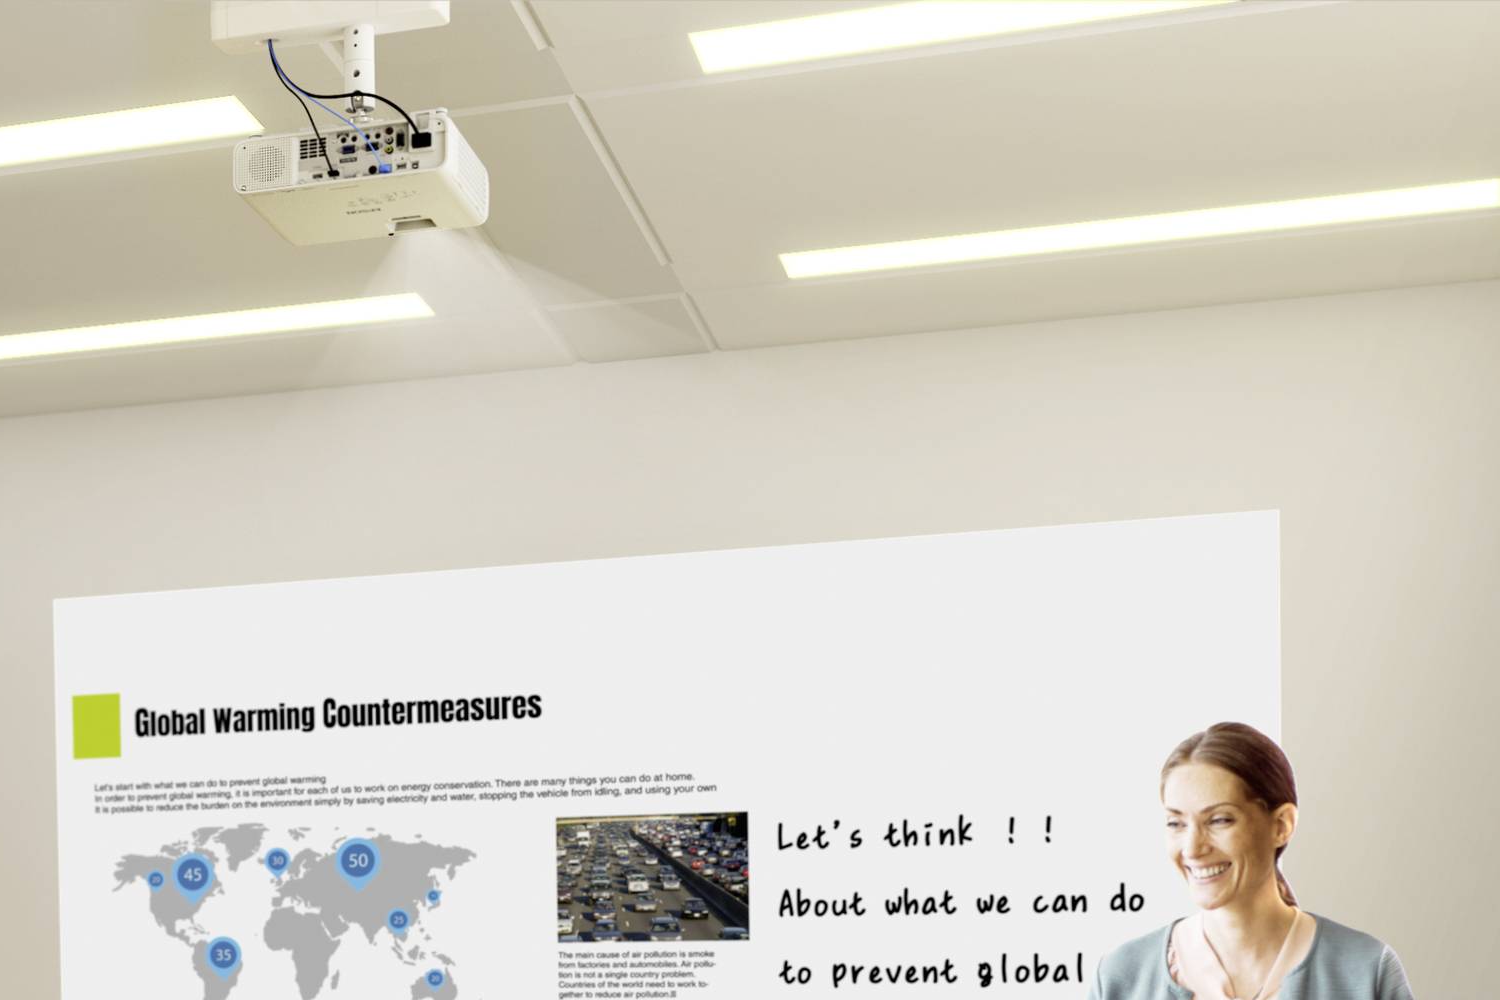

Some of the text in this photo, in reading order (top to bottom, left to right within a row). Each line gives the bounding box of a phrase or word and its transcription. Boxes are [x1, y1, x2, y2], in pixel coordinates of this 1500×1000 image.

[135, 695, 542, 737] Global Warming Countermeasures
[94, 784, 114, 792] Let's
[114, 783, 134, 792] start
[135, 783, 153, 791] with
[153, 782, 174, 790] what
[206, 780, 218, 788] do
[219, 780, 228, 788] to
[229, 779, 261, 789] prevent
[262, 778, 288, 788] global
[290, 777, 327, 787] warming
[104, 794, 126, 802] order
[127, 793, 136, 801] to
[136, 792, 168, 802] prevent
[168, 791, 194, 801] global
[195, 790, 232, 800] warming,
[235, 789, 241, 797] it
[242, 789, 250, 797] is
[251, 788, 292, 798] important
[293, 787, 305, 795] for
[306, 786, 329, 795] each
[330, 786, 339, 794] of
[353, 785, 363, 793] to
[364, 784, 386, 793] work
[400, 784, 432, 793] energy
[433, 780, 492, 790] conservation.
[496, 779, 522, 788] There
[540, 779, 567, 788] many
[568, 776, 597, 787] things
[599, 777, 617, 786] you
[618, 776, 637, 784] can
[638, 774, 652, 783] do
[653, 774, 663, 783] at
[665, 773, 694, 782] home.
[94, 806, 101, 814] It
[101, 805, 110, 813] is
[110, 804, 145, 814] possible
[145, 804, 155, 812] to
[155, 803, 184, 811] reduce
[185, 802, 199, 810] the
[200, 801, 230, 810] burden
[244, 800, 259, 808] the
[260, 798, 312, 808] environment
[314, 797, 342, 807] simply
[343, 796, 354, 806] by
[356, 795, 385, 806] saving
[386, 794, 429, 805] electricity
[430, 793, 448, 802] and
[449, 792, 475, 802] water,
[478, 791, 518, 801] stopping
[519, 790, 535, 799] the
[536, 789, 569, 798] vehicle
[570, 788, 592, 797] from
[594, 787, 621, 797] idling,
[624, 786, 643, 795] and
[645, 785, 671, 796] using
[673, 786, 694, 795] your
[696, 785, 717, 793] own
[778, 814, 1051, 850] Let's think ! !
[272, 857, 283, 865] 30
[349, 854, 368, 867] 50
[184, 869, 202, 881] 45
[779, 883, 1144, 917] About what we can do
[216, 950, 231, 961] 35
[559, 951, 574, 959] The
[575, 951, 595, 959] main
[643, 951, 678, 959] pollution
[687, 950, 715, 958] smoke
[558, 961, 576, 969] from
[577, 961, 611, 969] factories
[693, 960, 716, 969] pollu-
[779, 953, 1082, 988] to prevent global
[604, 971, 628, 979] single
[629, 971, 660, 979] country
[661, 970, 695, 979] problem.
[645, 980, 666, 988] need
[667, 980, 676, 988] to
[676, 980, 696, 988] work
[698, 980, 708, 988] to-
[558, 991, 584, 999] gether
